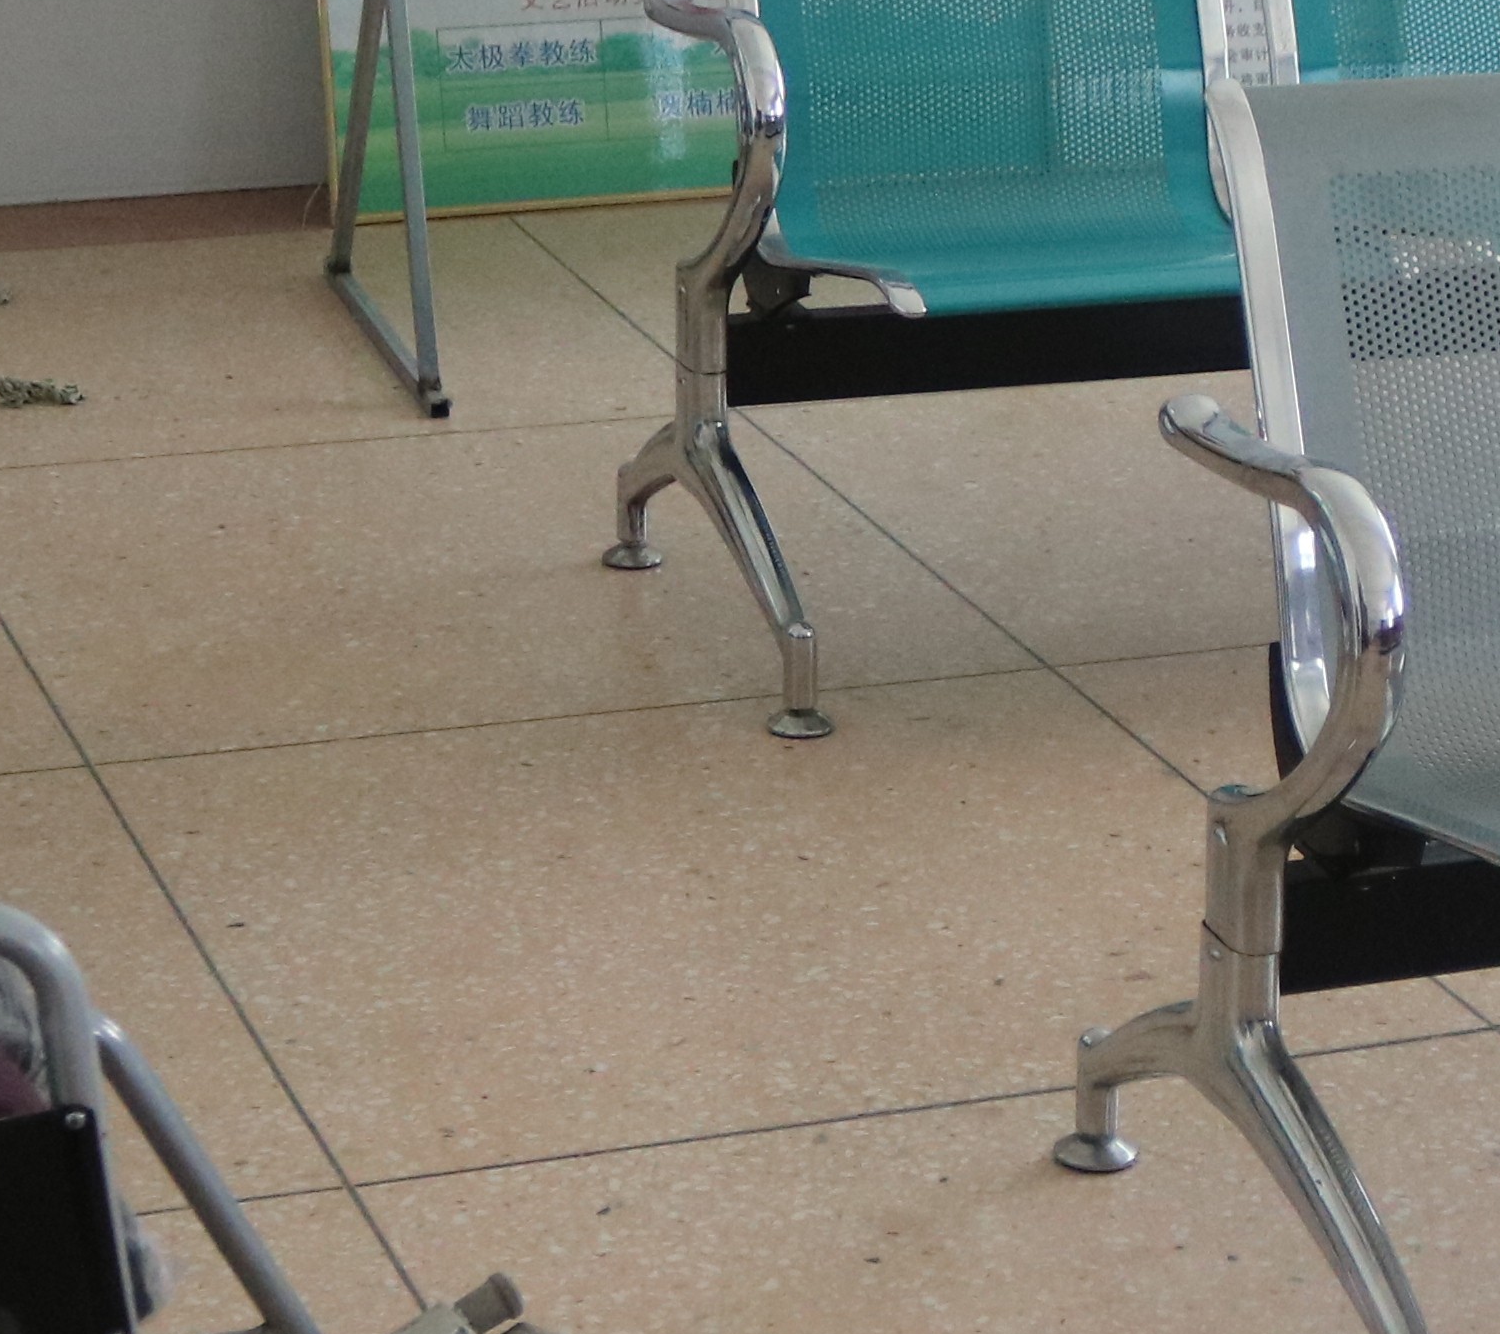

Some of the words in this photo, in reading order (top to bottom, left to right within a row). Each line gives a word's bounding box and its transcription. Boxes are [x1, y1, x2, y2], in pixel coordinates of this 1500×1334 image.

[449, 38, 598, 71] 太极拳教练
[466, 98, 586, 132] 舞蹈教练
